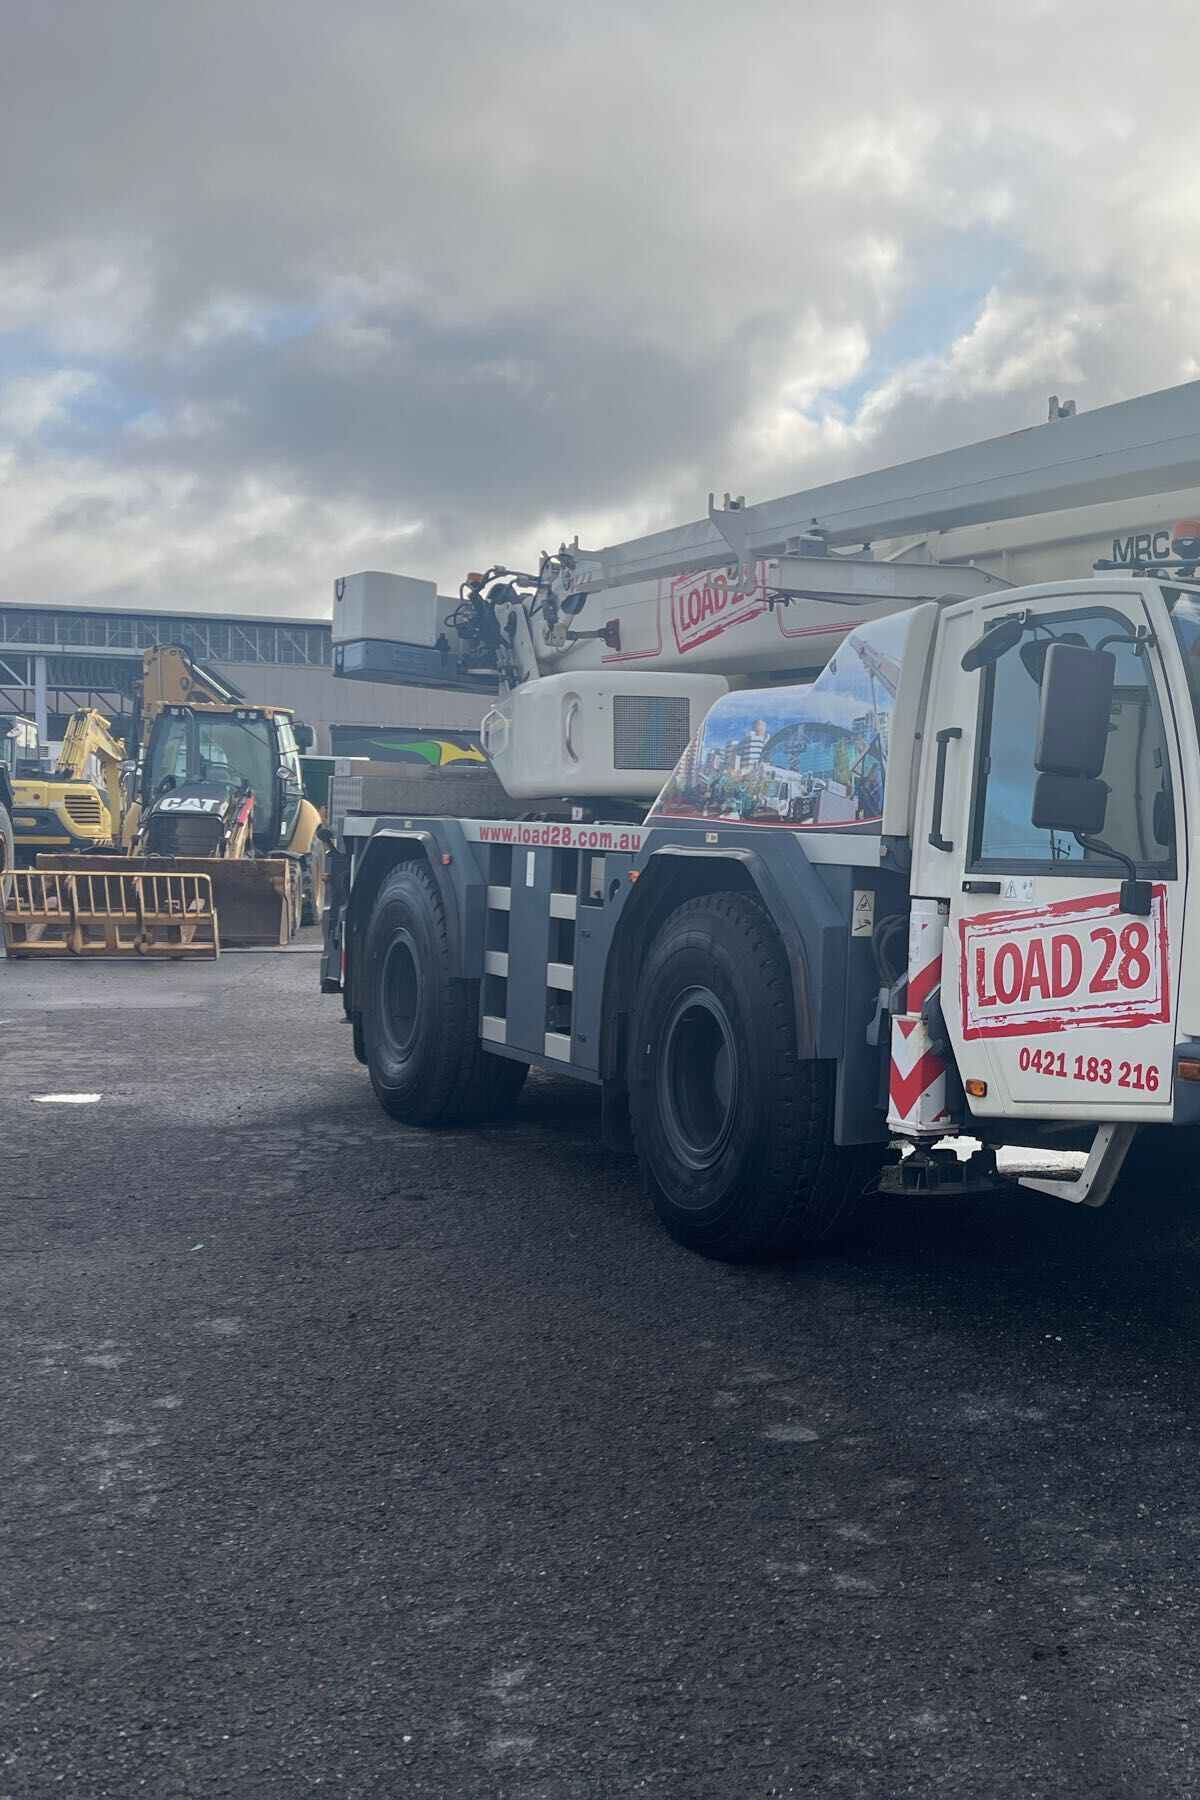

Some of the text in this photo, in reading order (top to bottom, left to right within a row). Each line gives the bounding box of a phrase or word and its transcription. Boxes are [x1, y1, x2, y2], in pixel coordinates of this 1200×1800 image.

[160, 797, 220, 812] CAT
[479, 823, 641, 851] www.load28.com.au
[975, 922, 1151, 1007] LOAD 28
[1019, 1047, 1160, 1092] 0421 183 216
